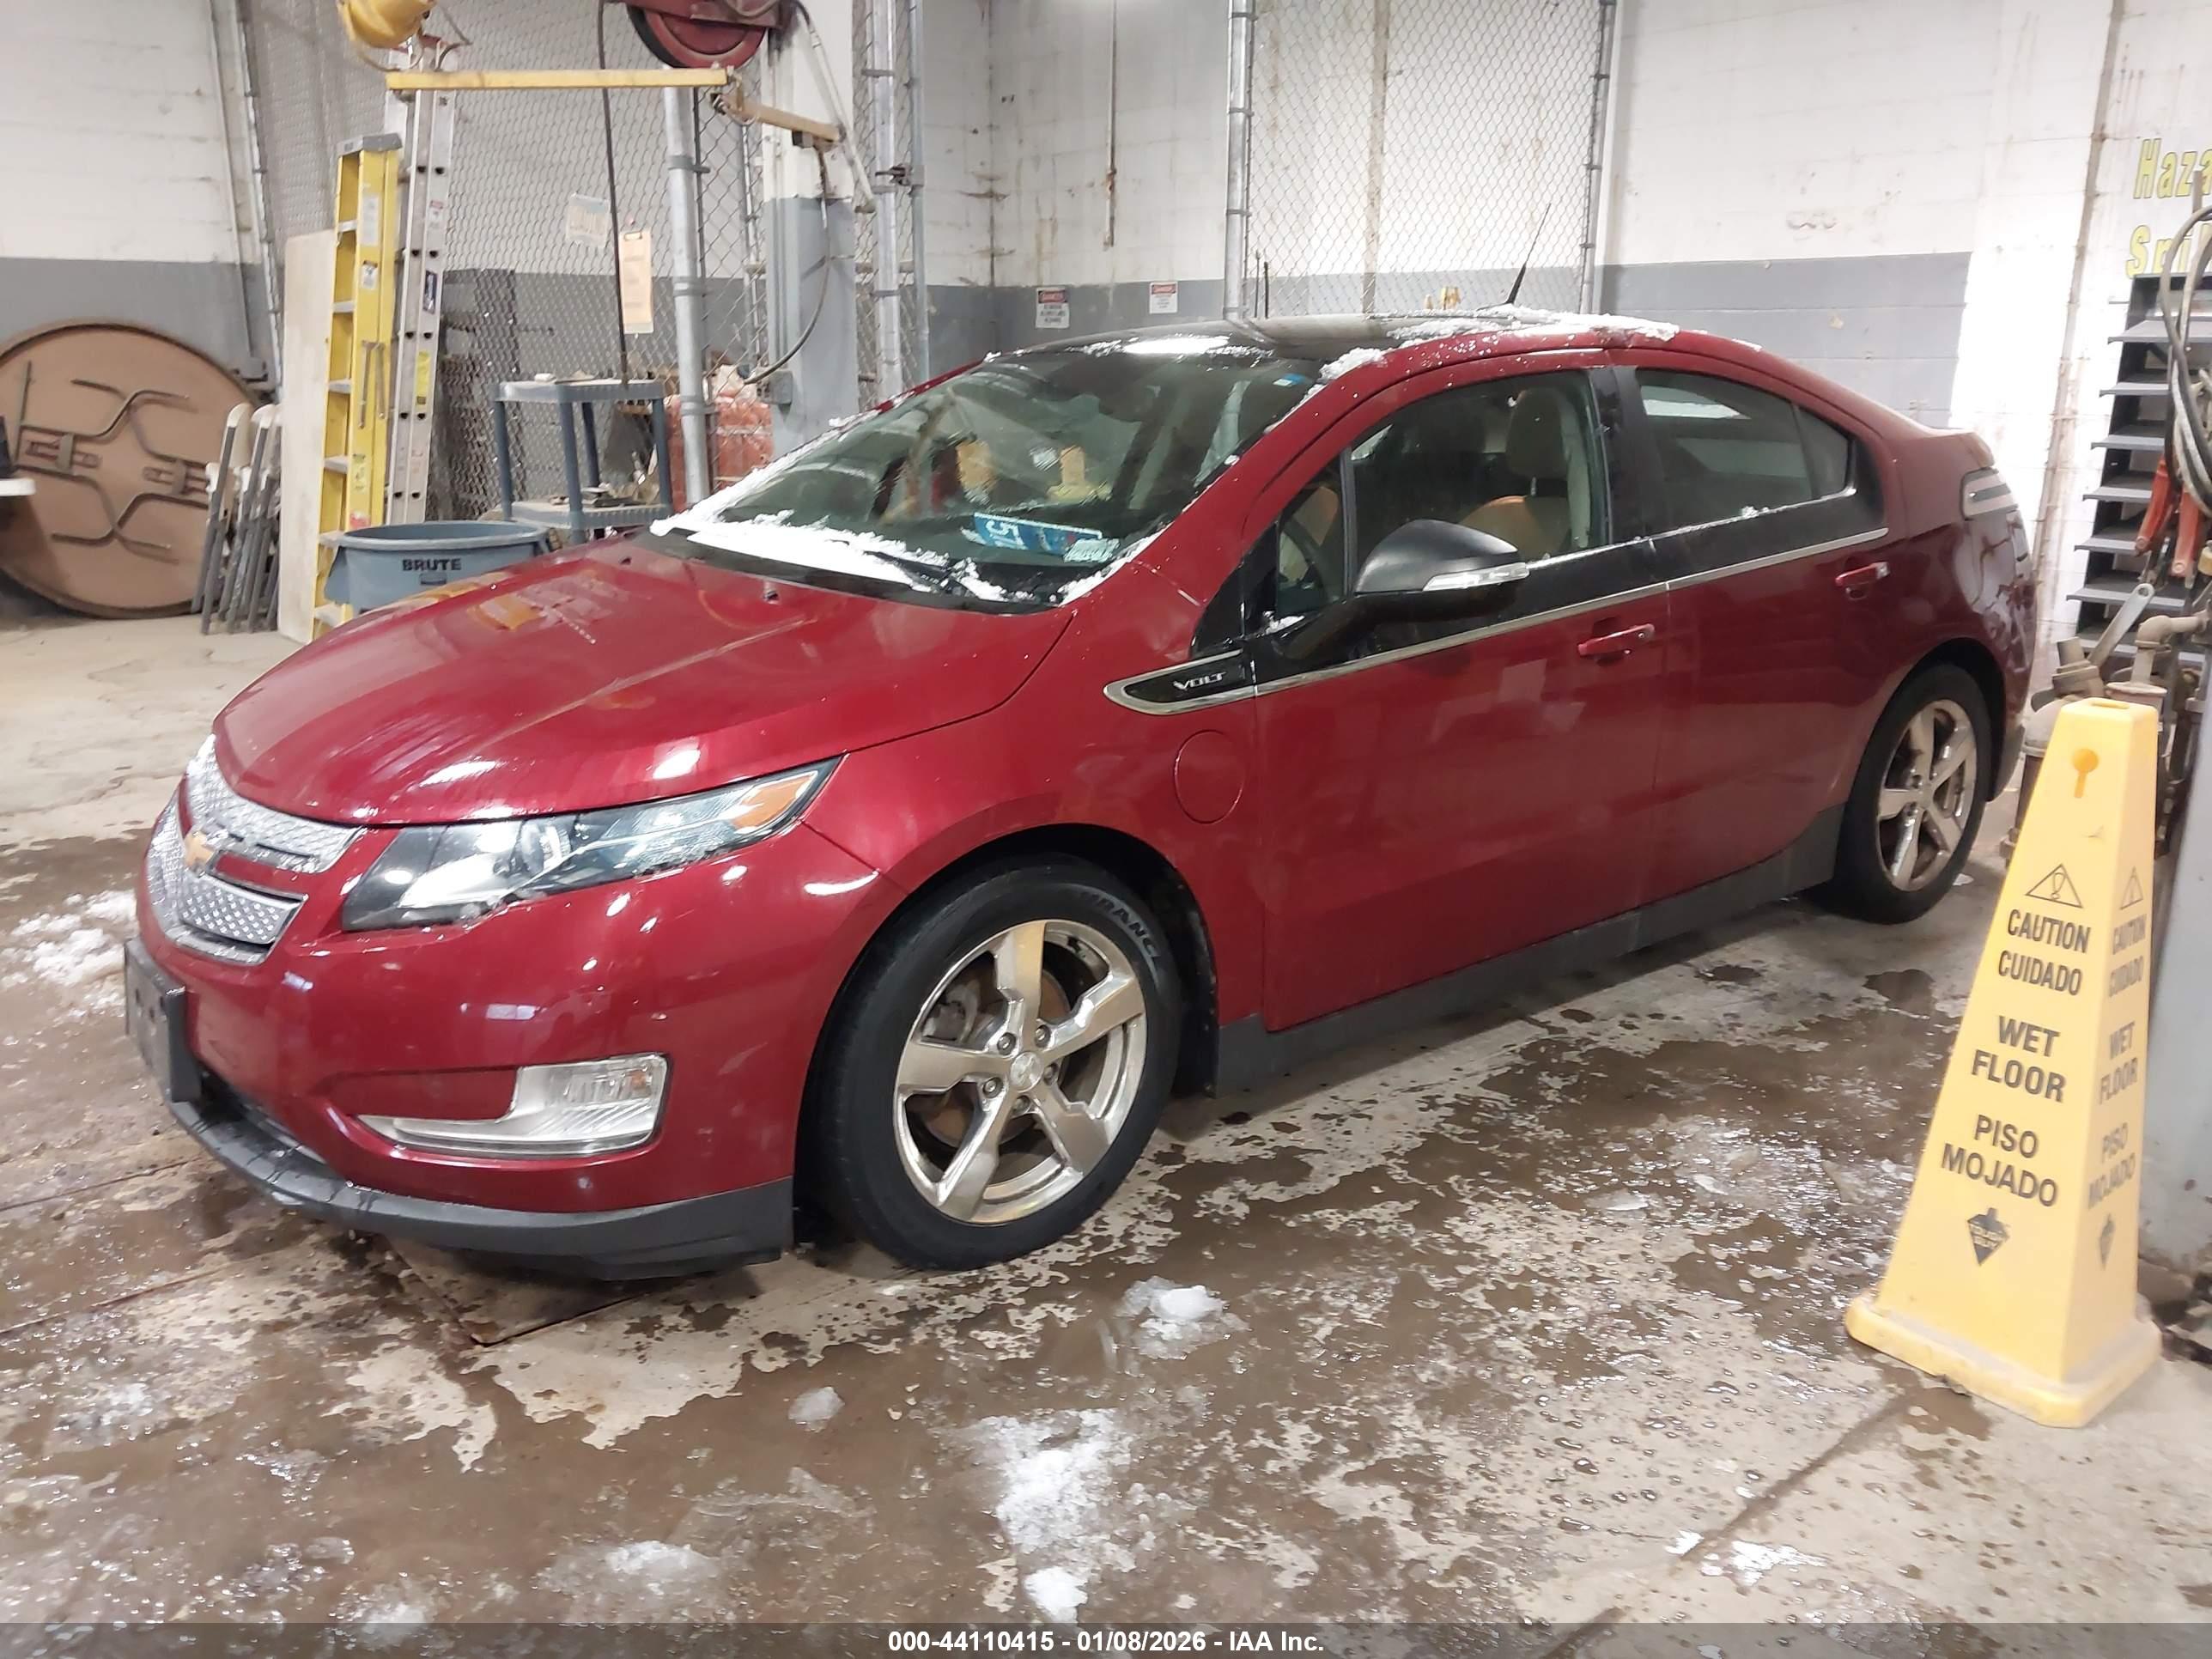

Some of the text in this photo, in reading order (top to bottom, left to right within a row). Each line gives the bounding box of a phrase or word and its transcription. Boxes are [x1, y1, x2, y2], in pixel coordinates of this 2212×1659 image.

[402, 558, 462, 572] BRUTE
[1173, 672, 1226, 691] VOLT
[2007, 908, 2092, 954] CAUTION
[1998, 950, 2083, 996] CUIDADO
[1998, 1015, 2061, 1057] WET
[2109, 1020, 2136, 1060] WET
[1972, 1048, 2068, 1103] FLOOR
[2099, 1057, 2138, 1105] FLOOR
[1974, 1114, 2039, 1158] PISO
[1941, 1142, 2059, 1207] MOJADO
